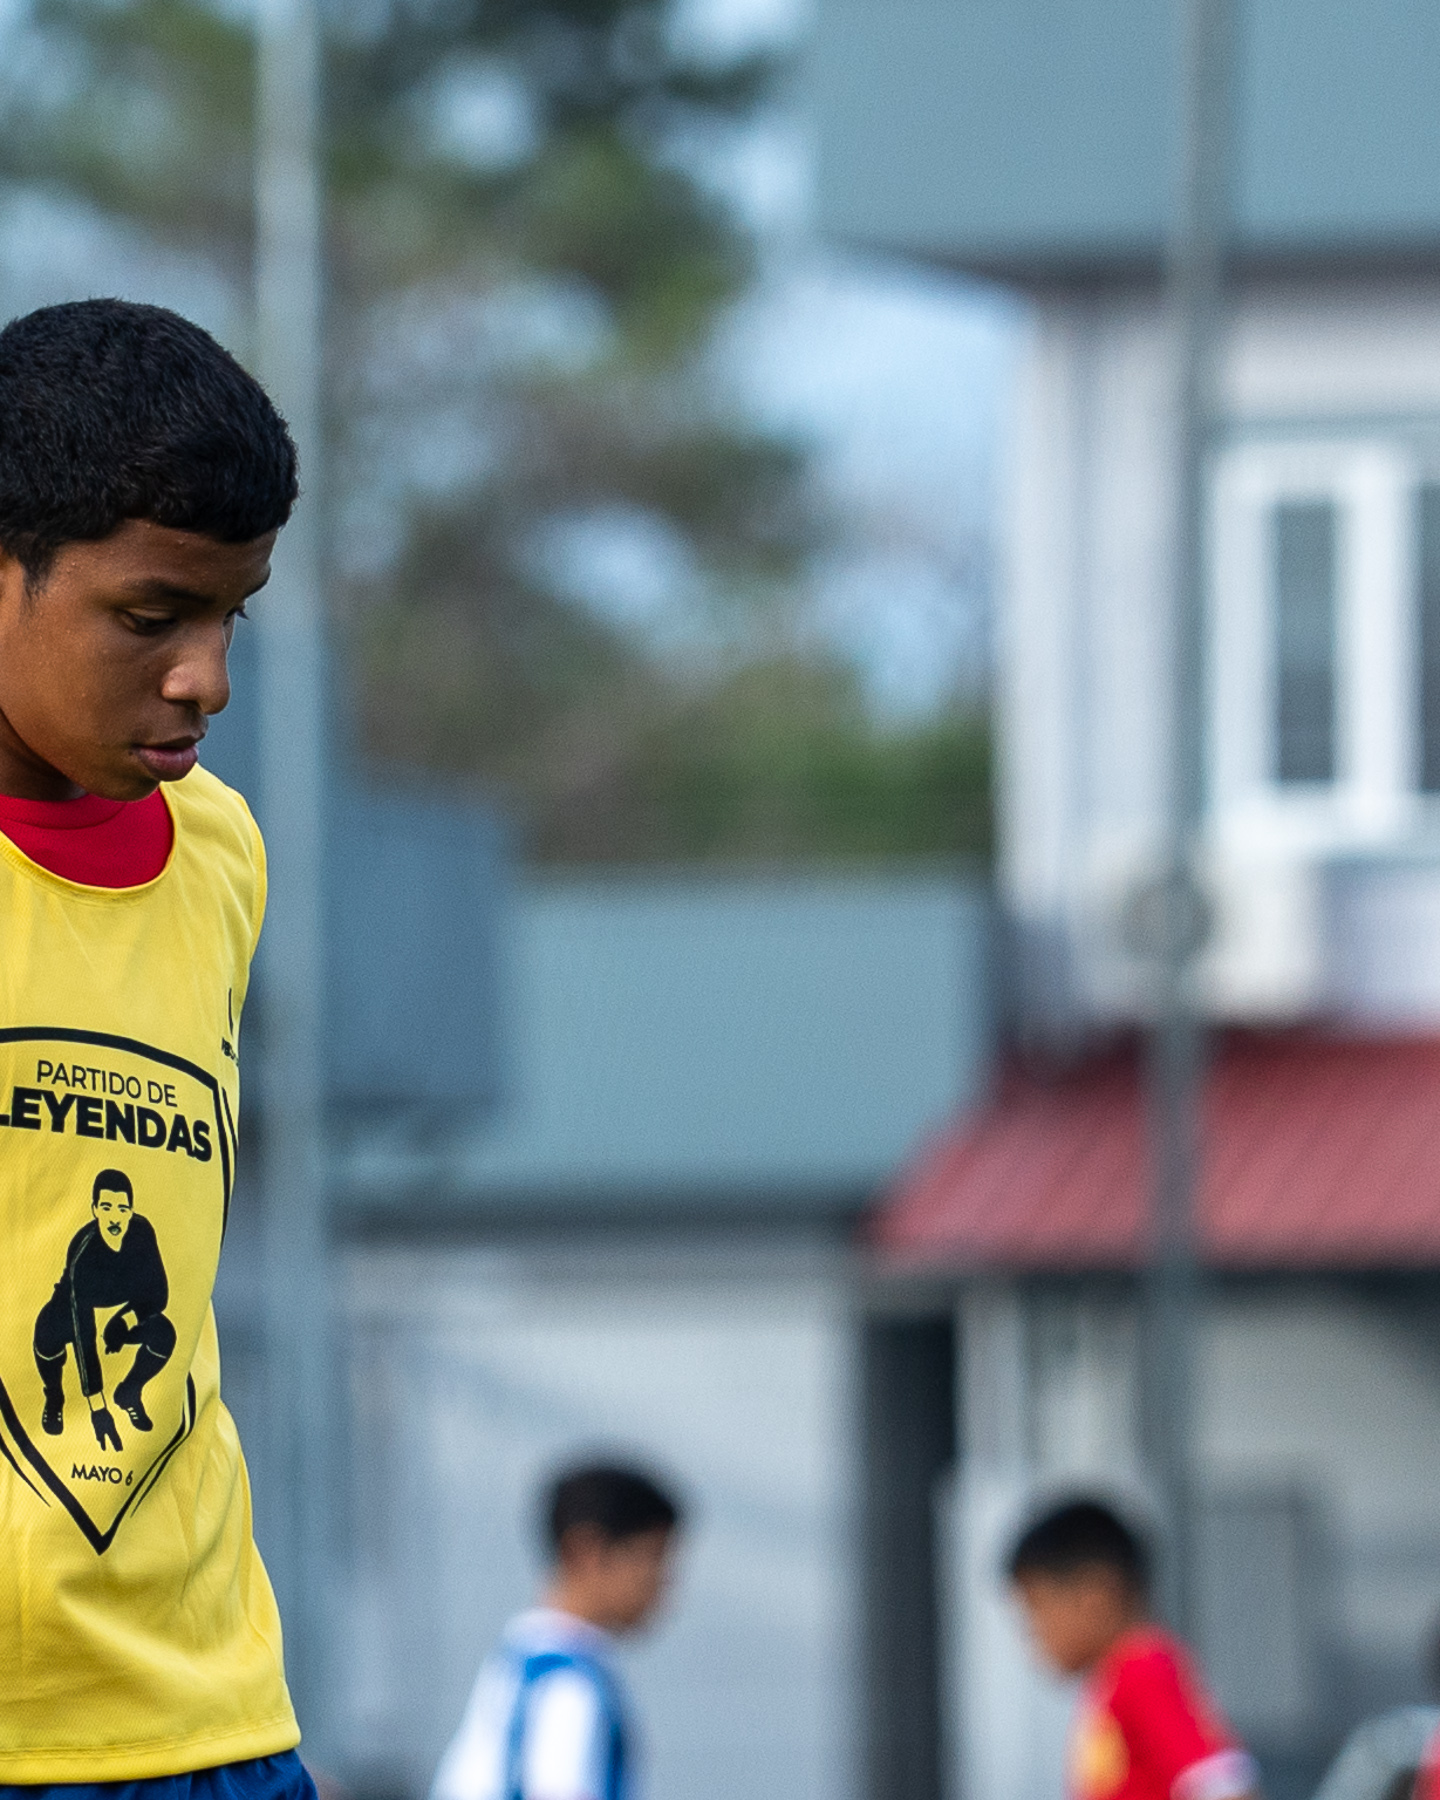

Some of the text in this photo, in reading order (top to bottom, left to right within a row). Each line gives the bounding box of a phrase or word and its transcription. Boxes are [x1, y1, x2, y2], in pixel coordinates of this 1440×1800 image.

[36, 1060, 178, 1107] PARTIDO DE
[71, 1463, 134, 1486] MAYO 6
